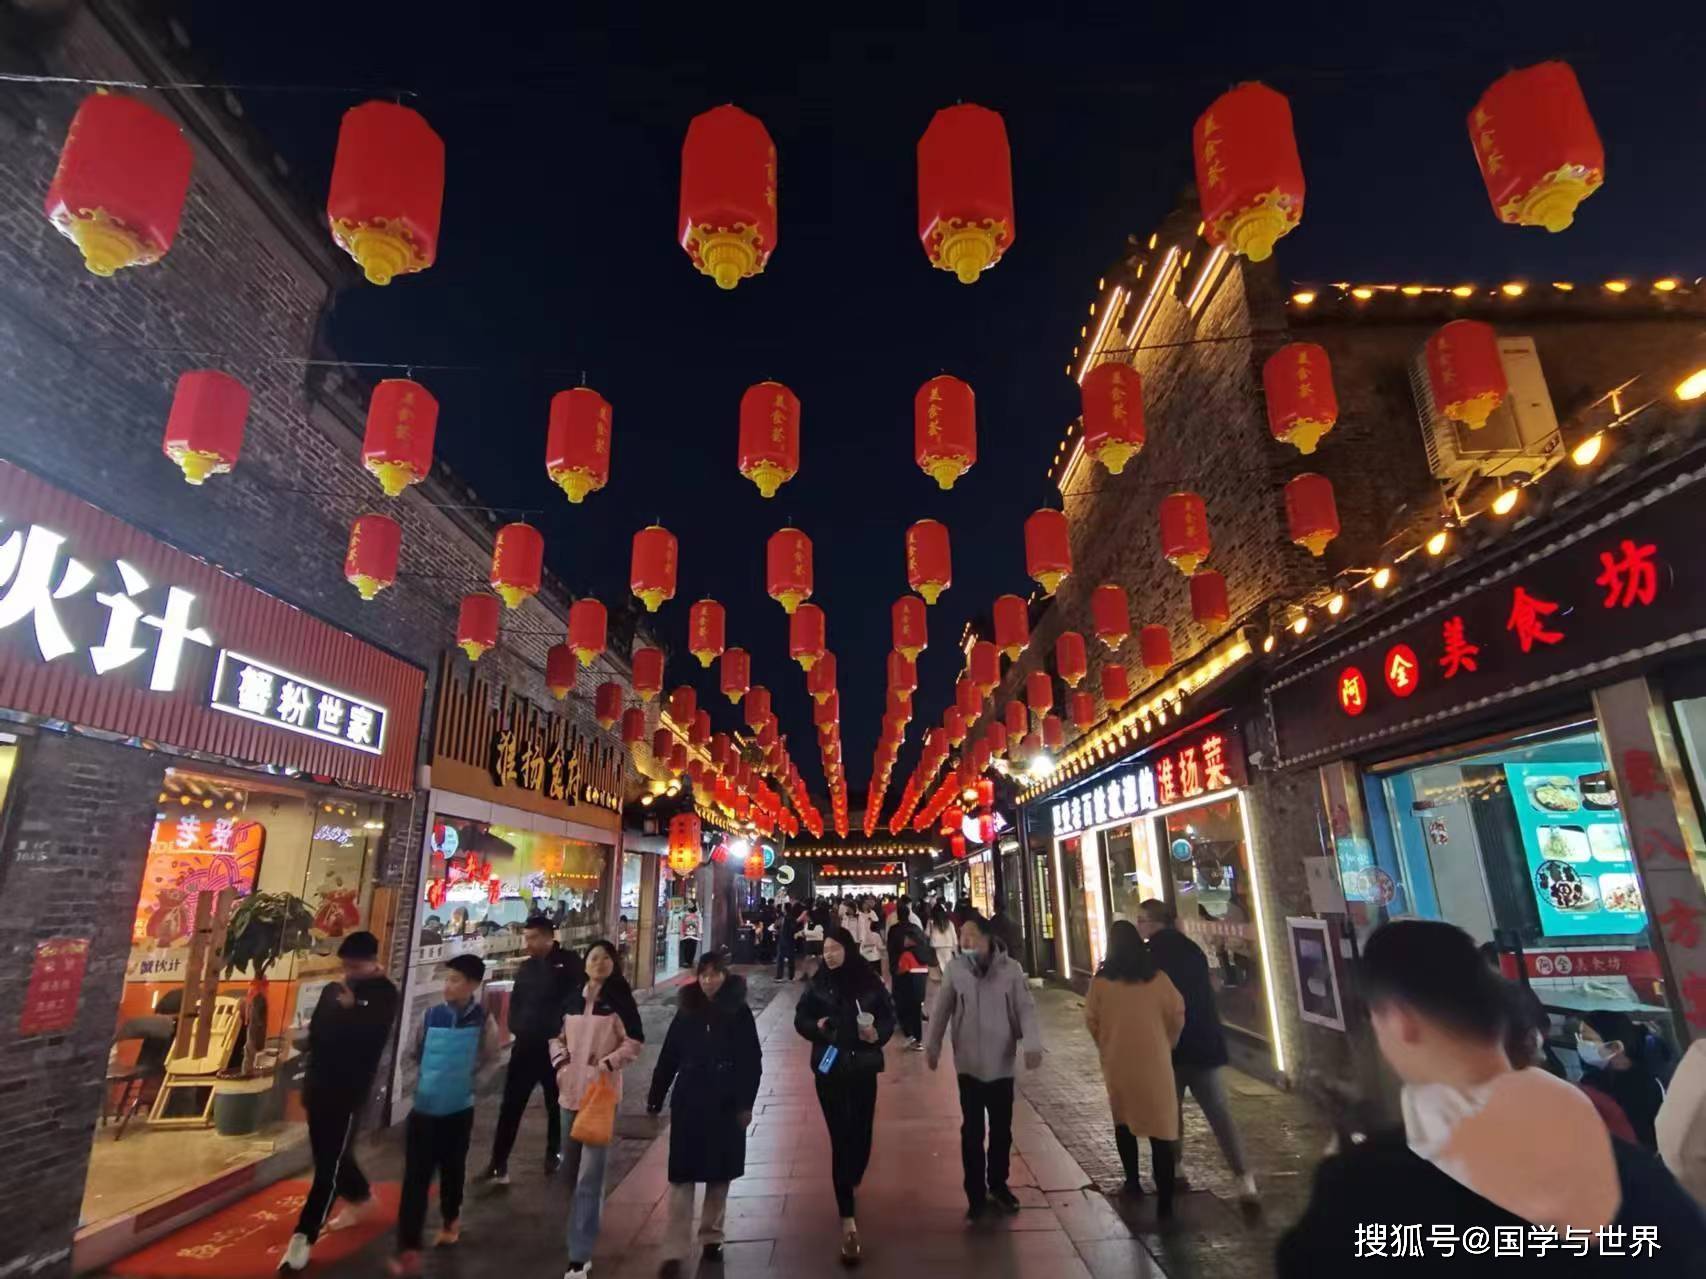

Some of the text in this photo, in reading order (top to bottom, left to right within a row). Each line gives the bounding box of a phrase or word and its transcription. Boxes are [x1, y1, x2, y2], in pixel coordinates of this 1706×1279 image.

[1342, 540, 1657, 707] 阿全美食坊
[1157, 736, 1232, 805] 淮扬菜
